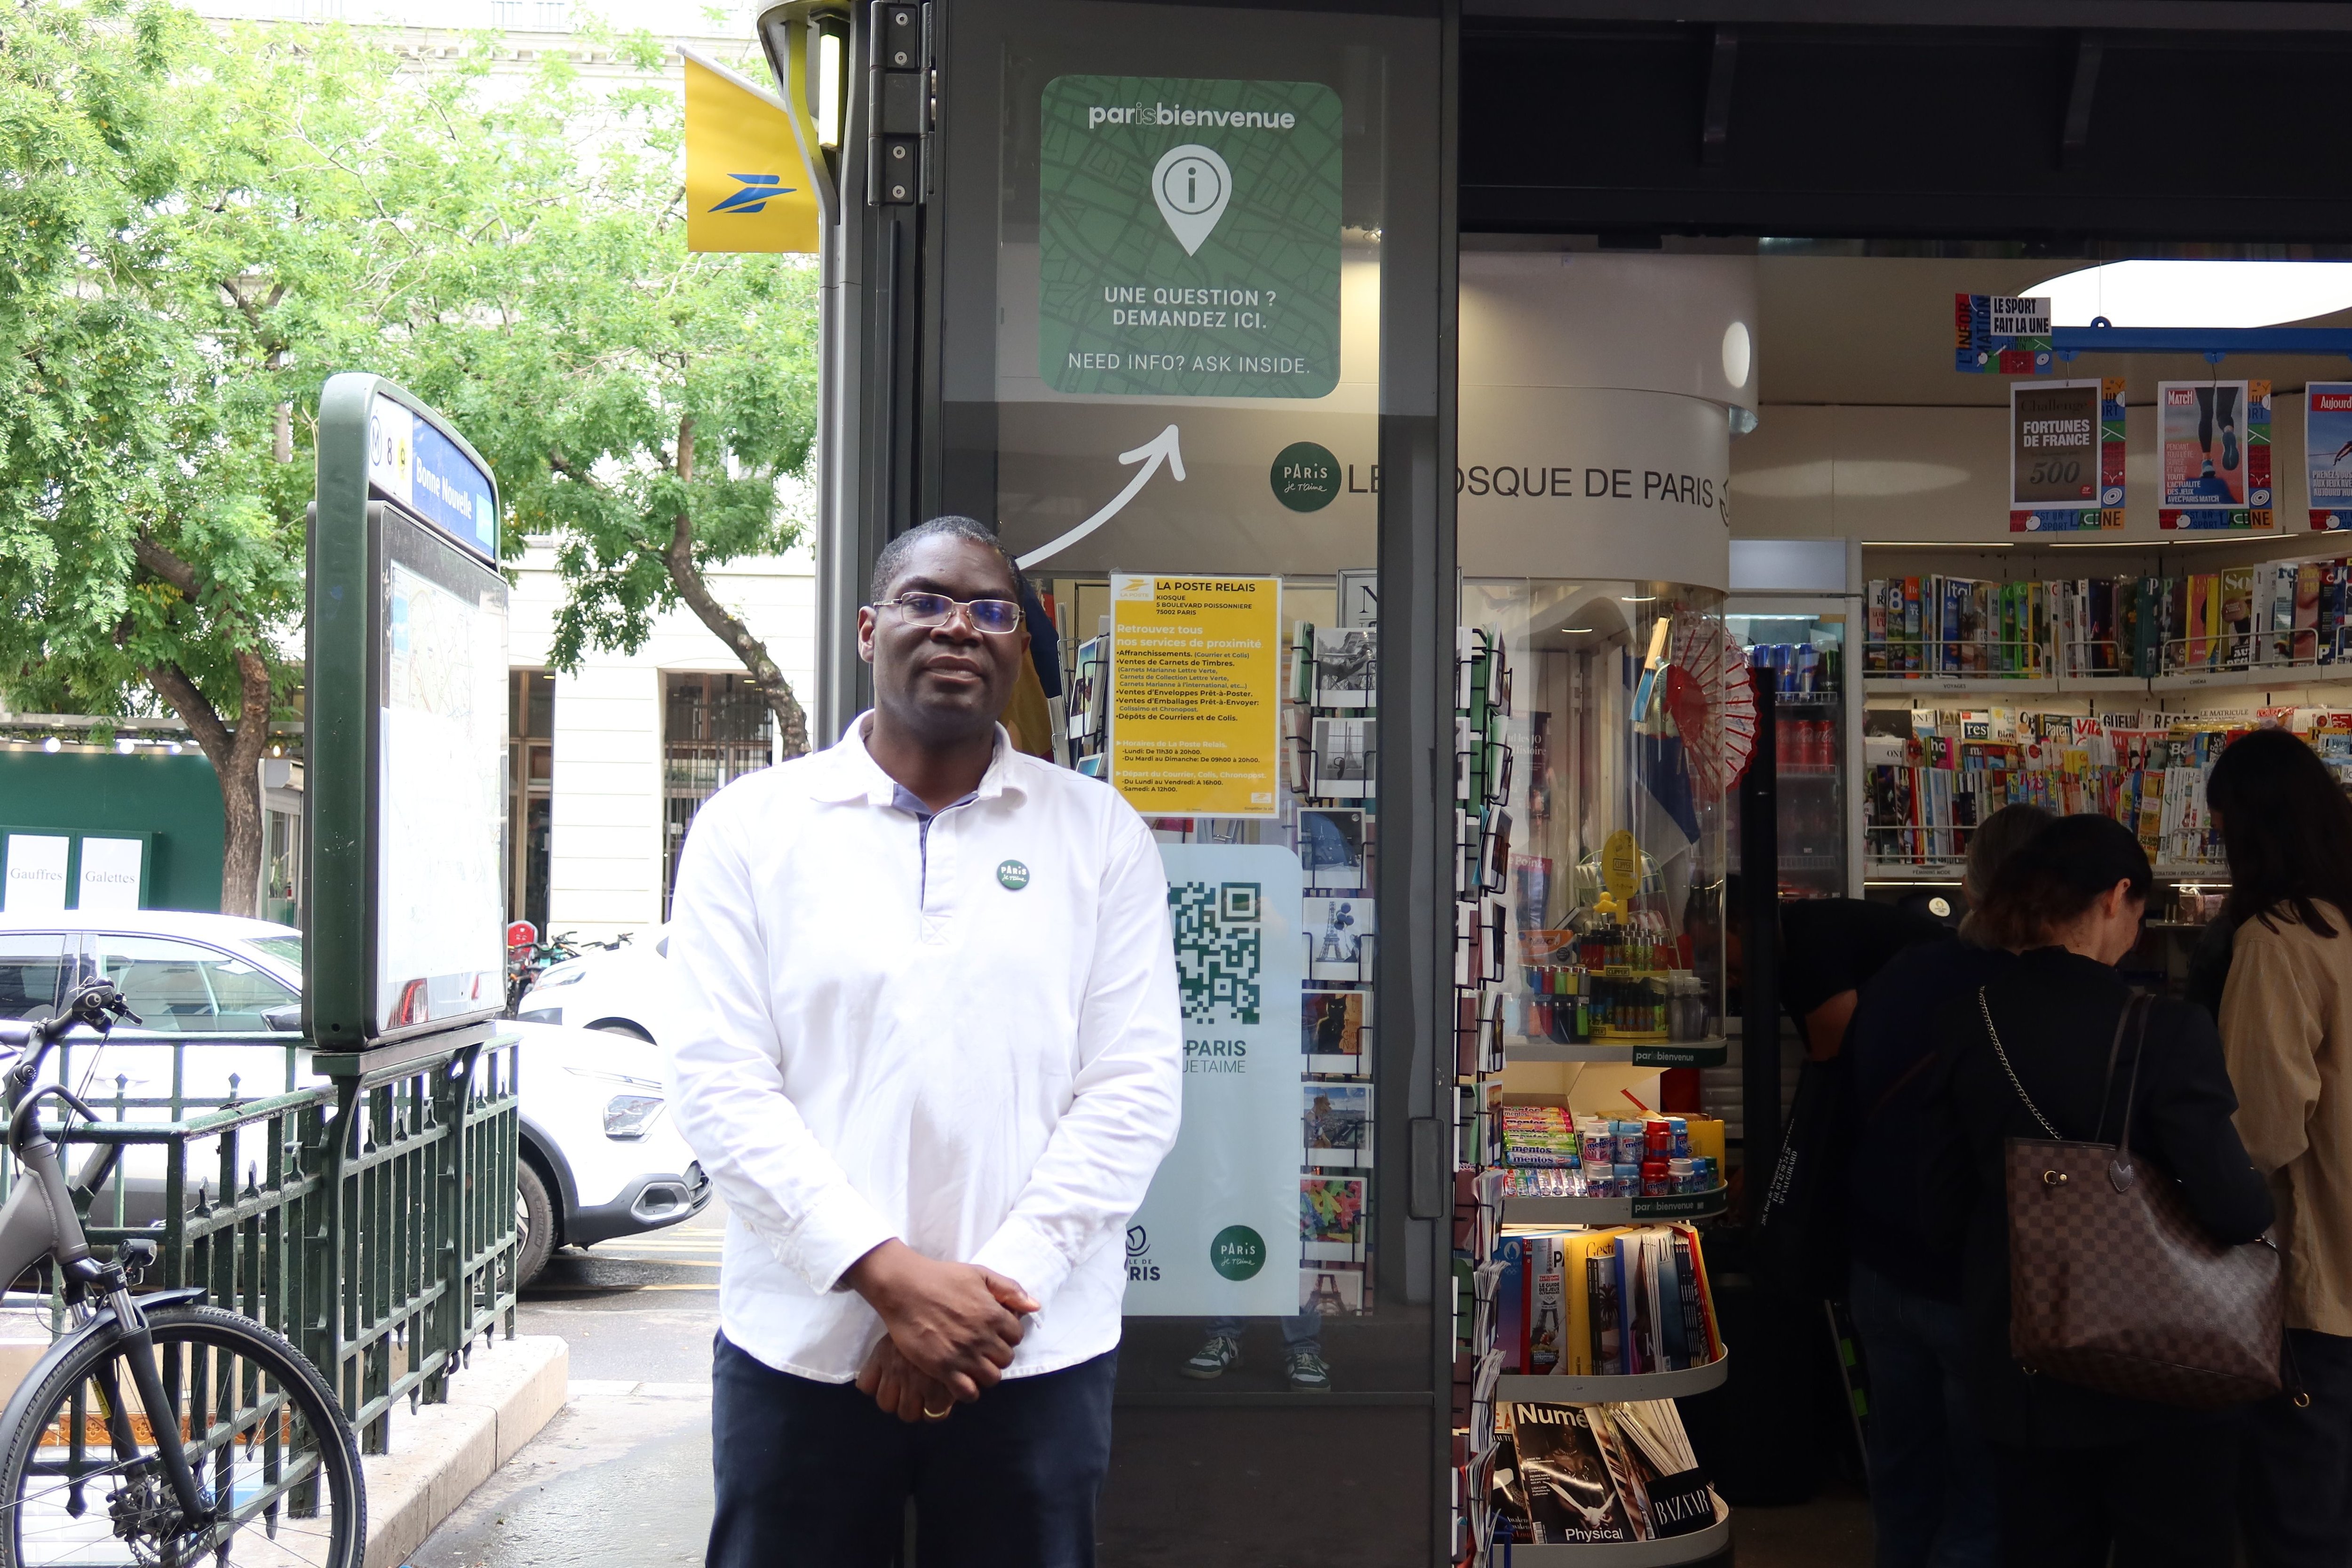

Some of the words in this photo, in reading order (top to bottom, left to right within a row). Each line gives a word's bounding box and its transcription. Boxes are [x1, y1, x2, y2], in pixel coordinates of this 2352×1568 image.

[1089, 102, 1295, 129] parisbienvenue
[1104, 287, 1146, 304] UNE
[1153, 287, 1259, 306] QUESTION
[1266, 290, 1277, 306] ?
[1994, 298, 2002, 314] LE
[2005, 299, 2036, 314] SPORT
[1112, 309, 1226, 328] DEMANDEZ
[1234, 312, 1267, 328] ICI.
[1994, 317, 2014, 333] FAIT
[2016, 318, 2026, 333] LA
[2029, 318, 2049, 333] UNE
[1069, 352, 1120, 370] NEED
[1129, 355, 1184, 371] INFO?
[1192, 356, 1232, 372] ASK
[1240, 357, 1311, 374] INSIDE.
[2168, 391, 2193, 405] MATCH
[2023, 419, 2090, 434] FORTUNES
[2024, 435, 2039, 447] DE
[2042, 433, 2090, 446] FRANCE
[2030, 462, 2080, 484] 500
[416, 456, 440, 497] Bonne
[442, 475, 472, 520] Nouvelle
[1585, 468, 1632, 499] DE
[1644, 470, 1714, 509] PARIS
[1117, 624, 1175, 633] Retrouvez
[10, 868, 63, 881] Gauffres
[86, 871, 135, 883] Galettes
[1782, 1151, 1797, 1194] VAUGIRARD
[1128, 1266, 1161, 1281] RIS
[1517, 1403, 1589, 1429] Numé
[1655, 1489, 1710, 1525] BAZAAR
[1565, 1528, 1623, 1543] Physical
